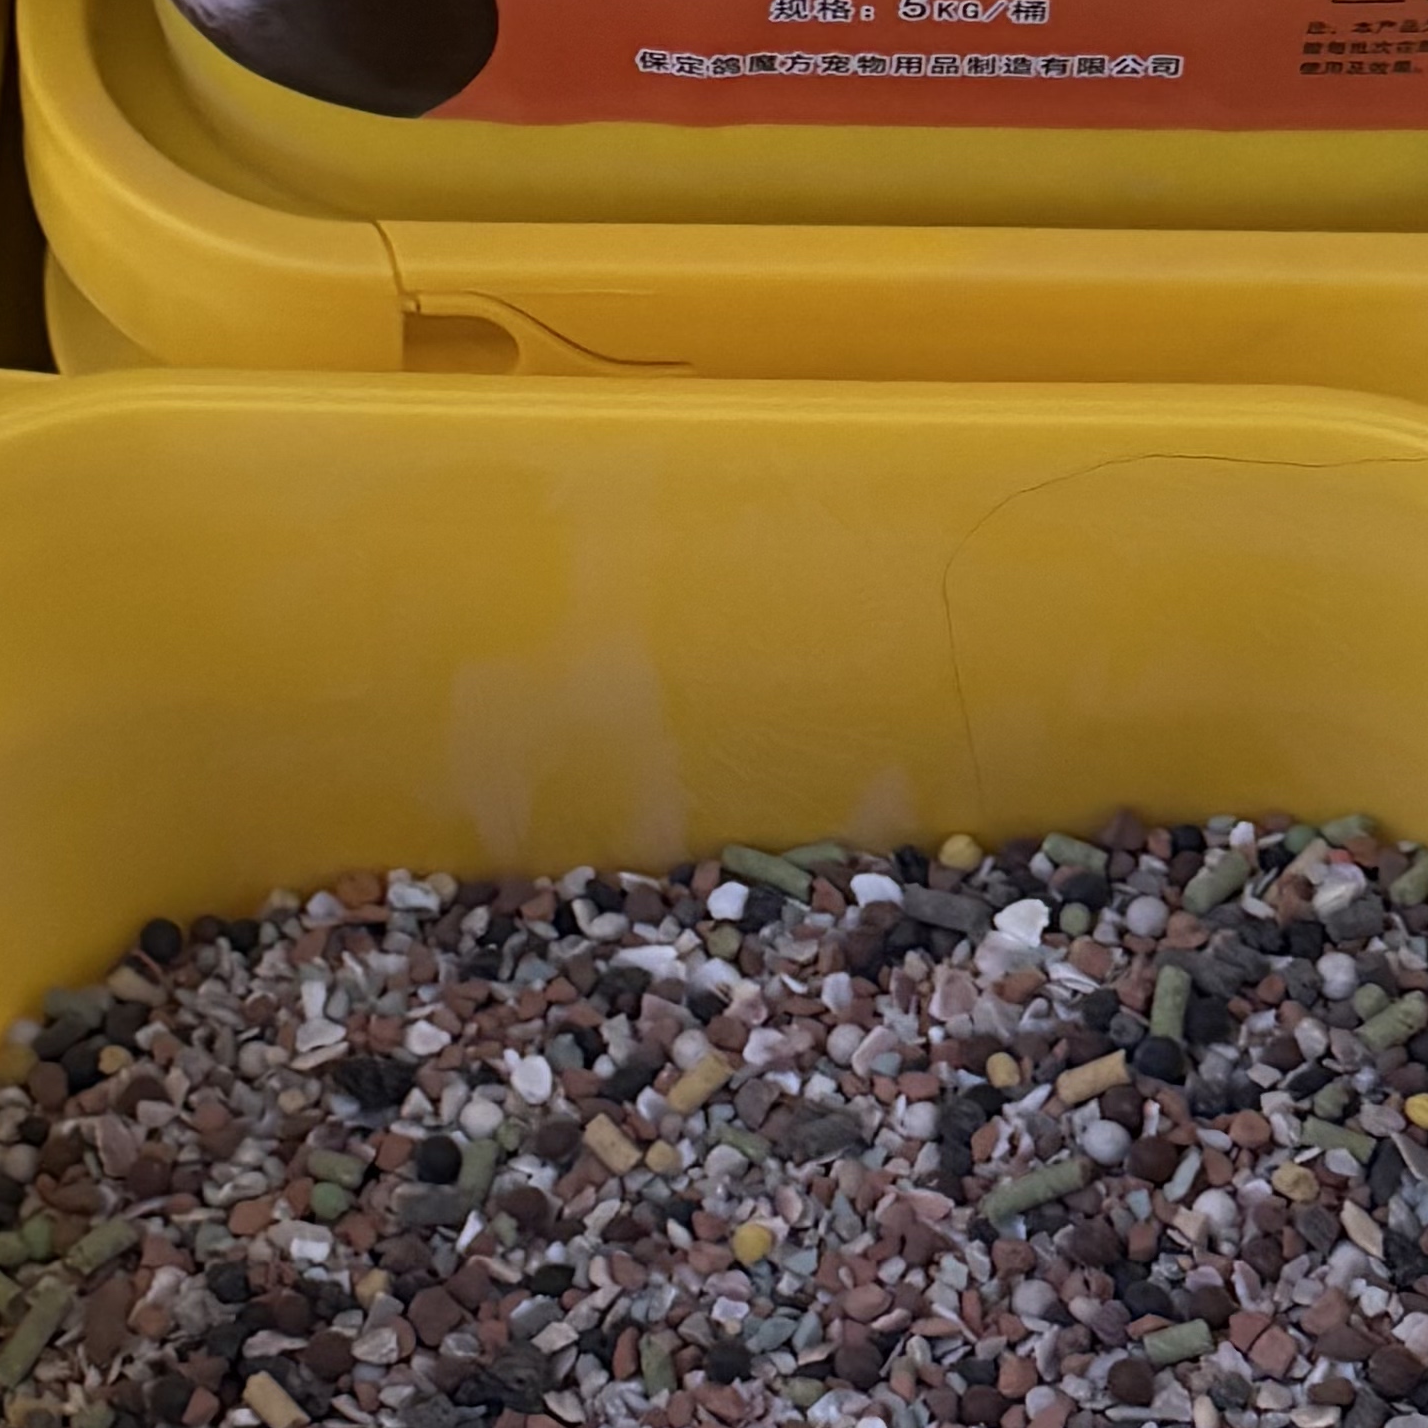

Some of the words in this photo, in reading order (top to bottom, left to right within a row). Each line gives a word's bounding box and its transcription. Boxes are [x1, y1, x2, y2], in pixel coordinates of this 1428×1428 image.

[635, 49, 1185, 79] 保定鸽魔方宠物用品制造有限公司
